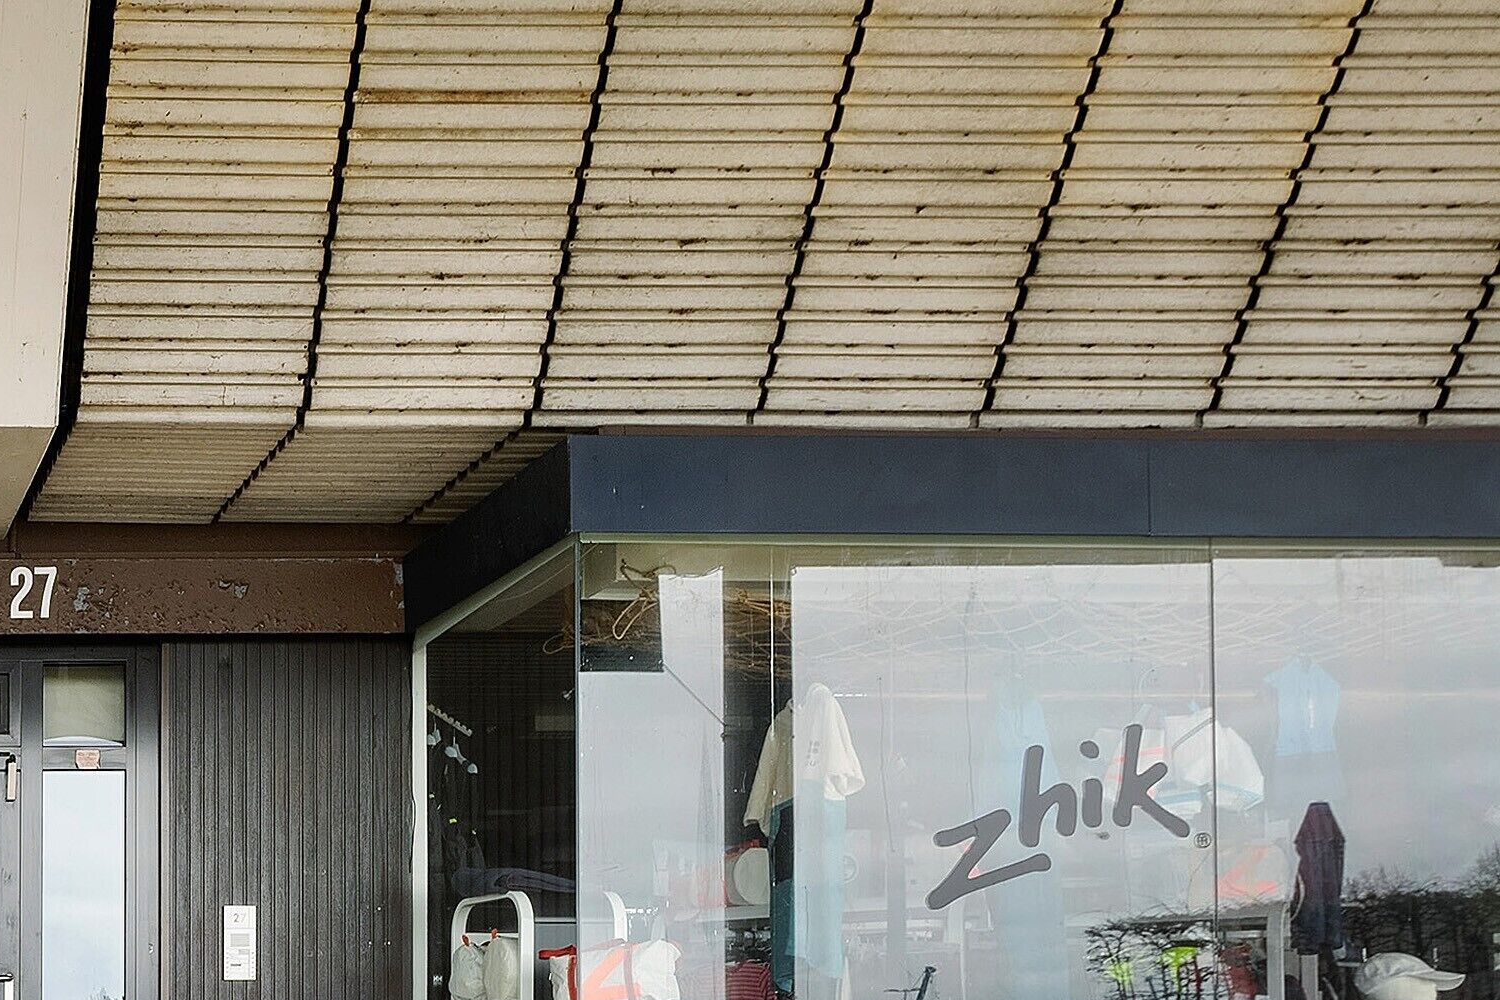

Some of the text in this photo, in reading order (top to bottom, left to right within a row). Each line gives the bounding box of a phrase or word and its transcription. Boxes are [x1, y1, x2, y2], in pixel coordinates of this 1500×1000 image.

[10, 566, 58, 620] 27
[925, 723, 1191, 911] zhik
[233, 912, 247, 923] 27
